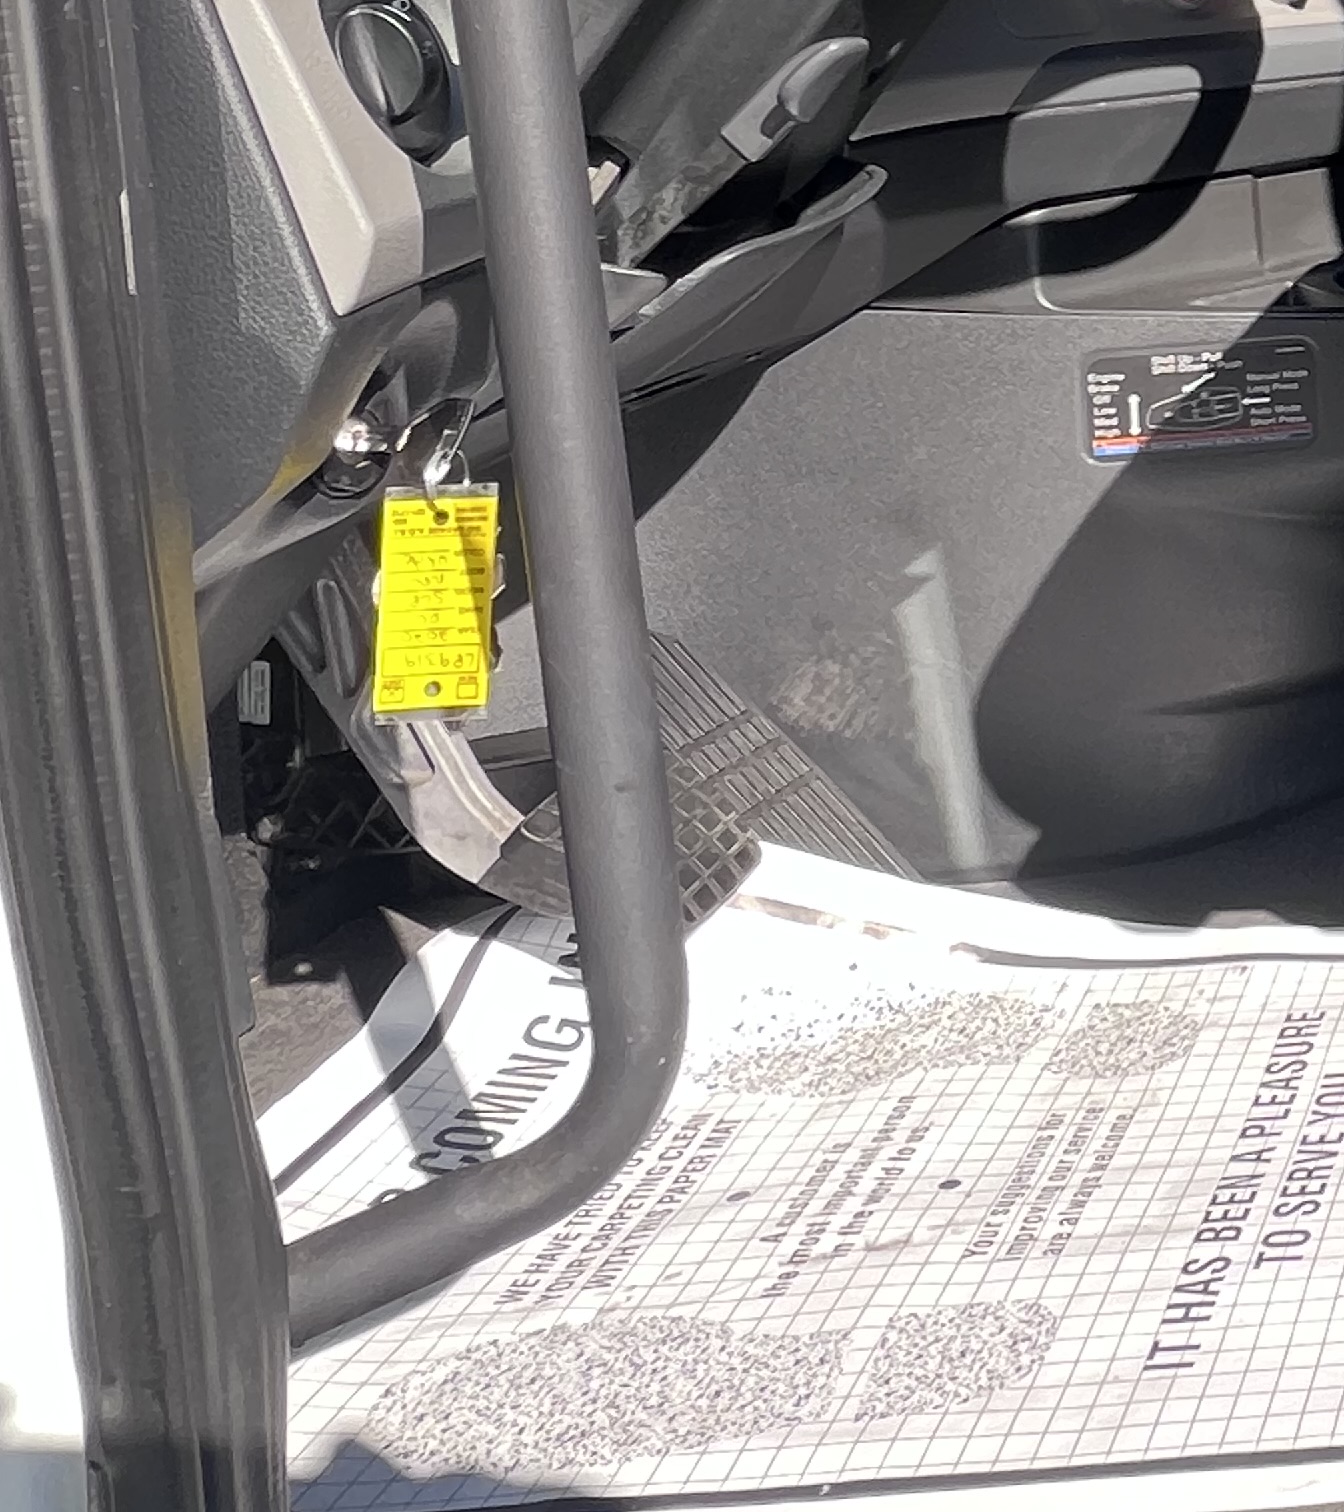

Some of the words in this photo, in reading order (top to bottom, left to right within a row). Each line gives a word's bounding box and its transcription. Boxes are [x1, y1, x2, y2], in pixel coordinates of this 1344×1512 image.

[409, 1015, 590, 1175] COMING
[1239, 1010, 1326, 1140] PLEASURE
[886, 1147, 917, 1161] to
[1048, 1159, 1076, 1182] our
[1063, 1107, 1105, 1155] service
[1229, 1146, 1277, 1164] A
[1272, 1131, 1344, 1218] SERVE
[533, 1254, 598, 1305] YOUR
[579, 1163, 674, 1256] CARPETING
[657, 1112, 716, 1163] CLEAN
[582, 1244, 643, 1288] WITH
[620, 1207, 674, 1248] THIS
[656, 1153, 718, 1204] PAPER
[701, 1119, 743, 1149] MAT
[759, 1232, 787, 1243] A
[775, 1159, 841, 1227] customer
[822, 1142, 852, 1154] is
[759, 1270, 800, 1298] the
[787, 1221, 831, 1265] most
[814, 1146, 884, 1216] important
[870, 1095, 917, 1144] person
[861, 1166, 905, 1207] world
[960, 1221, 1003, 1259] Your
[990, 1134, 1056, 1216] suggestions
[1037, 1112, 1068, 1131] for
[1057, 1176, 1102, 1226] always
[1193, 1172, 1266, 1244] BEEN
[493, 1278, 541, 1305] WE
[522, 1231, 581, 1275] HAVE
[563, 1181, 623, 1228] TRIED
[829, 1242, 855, 1258] in
[836, 1210, 875, 1236] the
[1043, 1232, 1073, 1256] are
[1253, 1228, 1311, 1270] TO
[1161, 1256, 1232, 1325] HAS
[1143, 1341, 1201, 1371] IT
